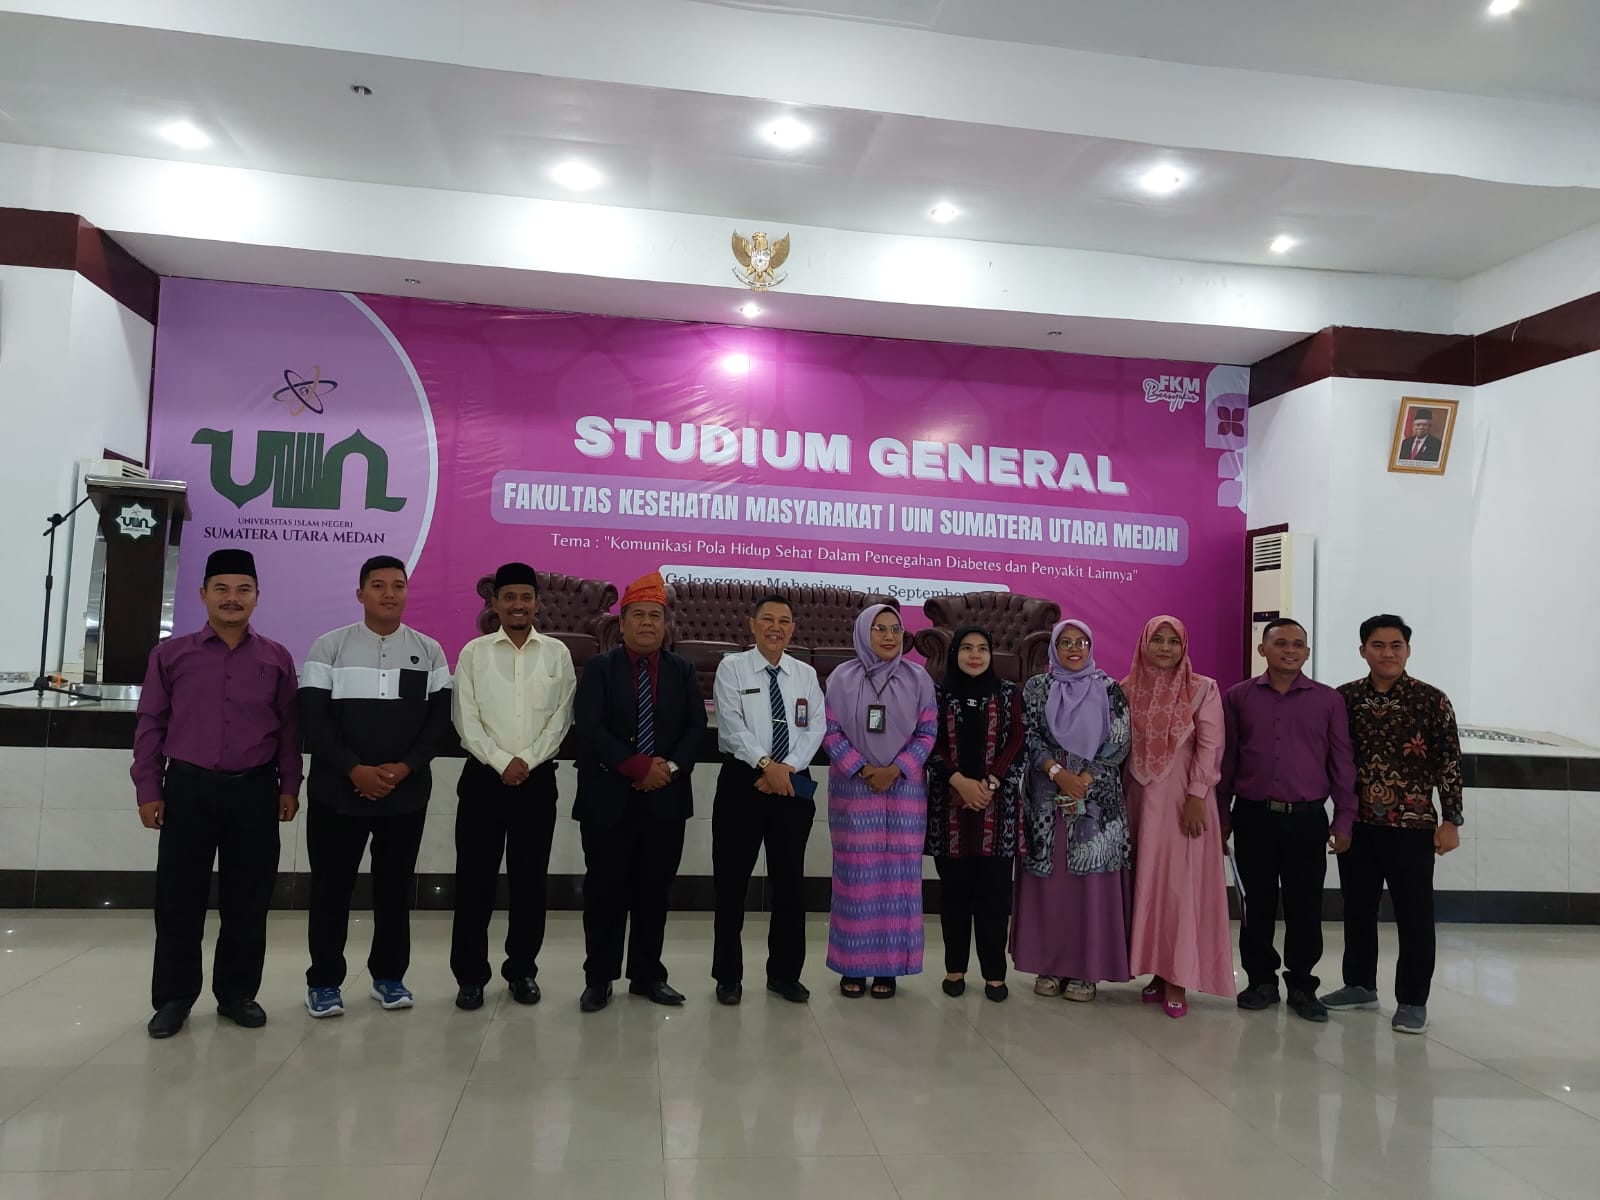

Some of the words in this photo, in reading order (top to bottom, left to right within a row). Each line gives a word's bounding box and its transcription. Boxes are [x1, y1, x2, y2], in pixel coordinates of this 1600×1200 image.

[1160, 374, 1200, 393] FKM
[574, 415, 851, 473] STUDIUM
[868, 437, 1129, 496] GENERAL
[238, 517, 292, 526] UNIVERSITAS
[294, 519, 320, 527] ISLAM
[321, 520, 353, 528] NEGERI
[503, 482, 612, 514] FAKULTAS
[619, 488, 738, 521] KESEHATAN
[746, 496, 883, 530] MASYARAKAT
[901, 506, 933, 533] UIN
[939, 509, 1043, 541] SUMATERA
[1049, 517, 1108, 547] UTARA
[1113, 523, 1178, 552] MEDAN
[203, 526, 278, 541] SUMATERA
[282, 529, 329, 542] UTARA
[332, 531, 385, 544] MEDAN
[550, 533, 591, 548] Tema
[604, 535, 692, 553] "Komunikasi
[697, 540, 726, 555] Pola
[731, 541, 771, 560] Hidup
[775, 544, 813, 560] Sehat
[818, 547, 860, 562] Dalam
[865, 550, 941, 569] Pencegahan
[946, 555, 1001, 572] Diabetes
[1005, 560, 1027, 574] dan
[1032, 562, 1083, 580] Penyakit
[1088, 566, 1137, 584] Lainnya"
[888, 584, 967, 601] Septembe
